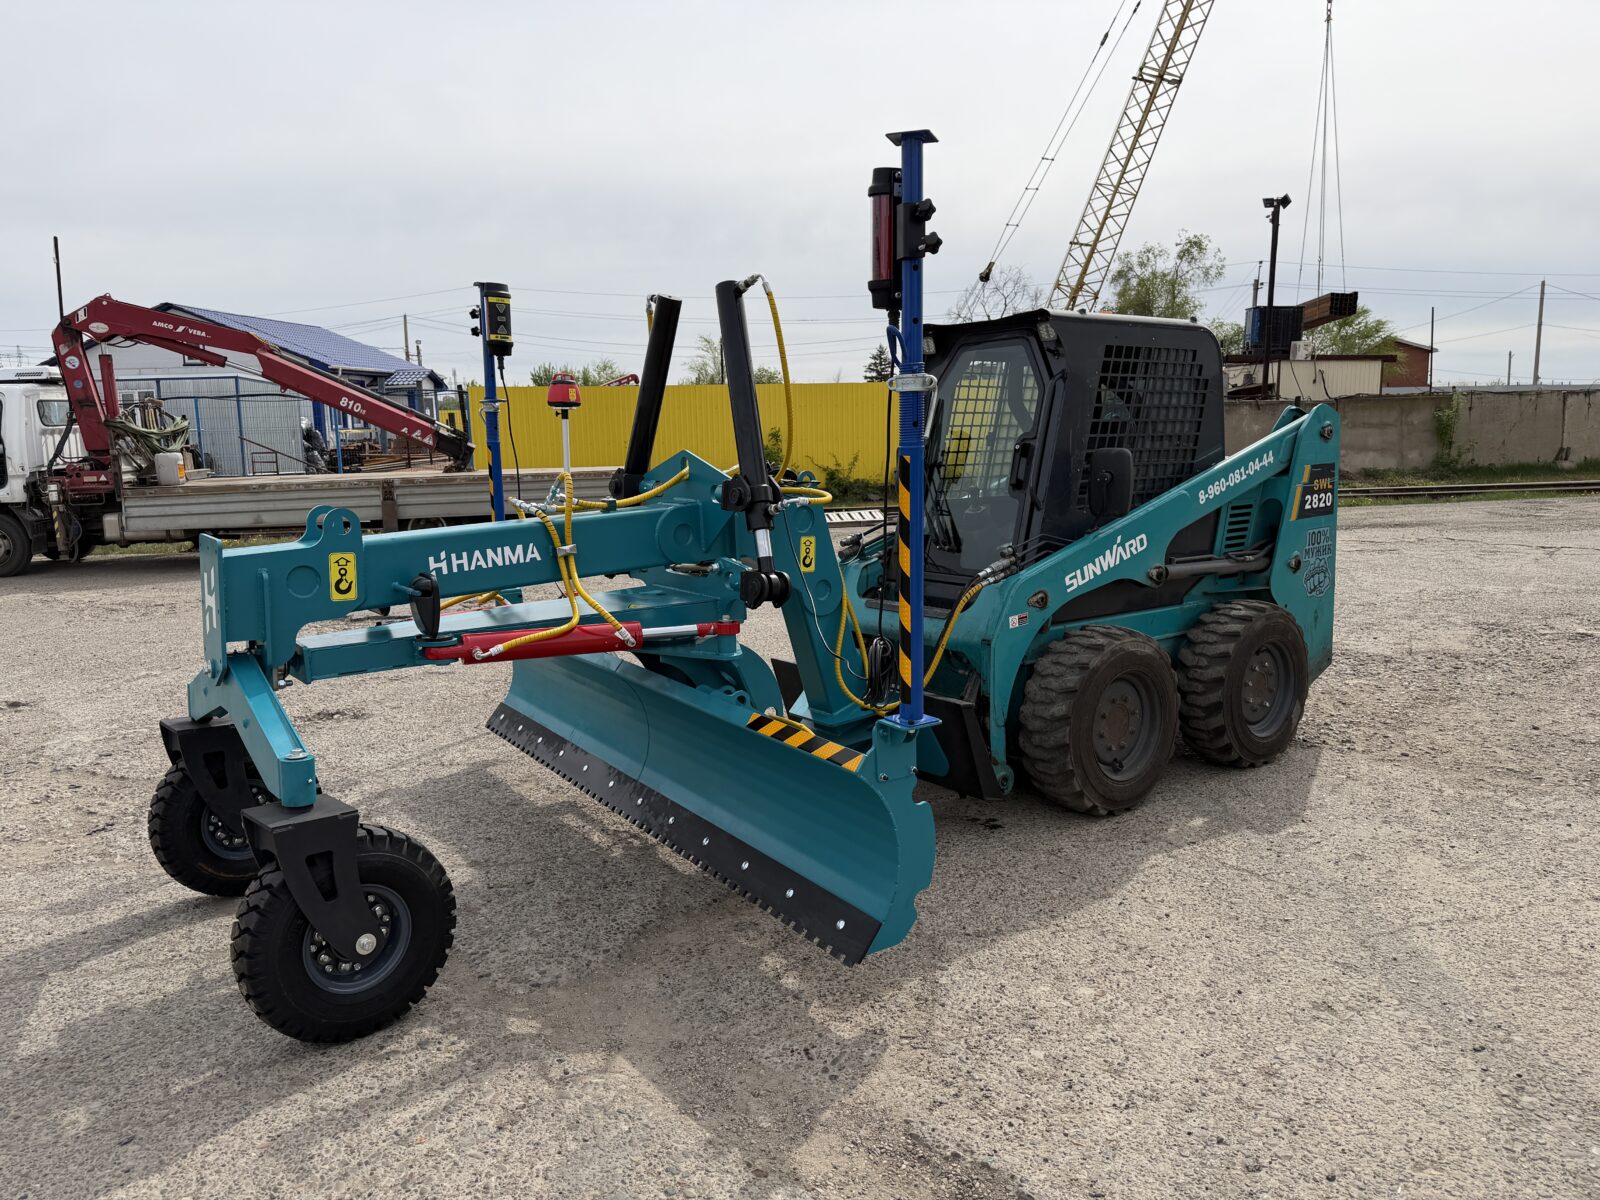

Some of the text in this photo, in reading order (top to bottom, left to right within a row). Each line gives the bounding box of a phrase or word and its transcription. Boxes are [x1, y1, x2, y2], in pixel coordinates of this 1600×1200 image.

[152, 320, 174, 330] AMCO
[188, 328, 206, 337] VEBA
[1198, 450, 1274, 505] 8-960-081-04-44
[1313, 477, 1333, 491] SWL
[1304, 492, 1332, 510] 2820
[1308, 529, 1330, 546] 100%
[450, 542, 542, 573] HANMA
[1304, 546, 1333, 560] МУЖИК
[1064, 533, 1148, 593] SUNWARD
